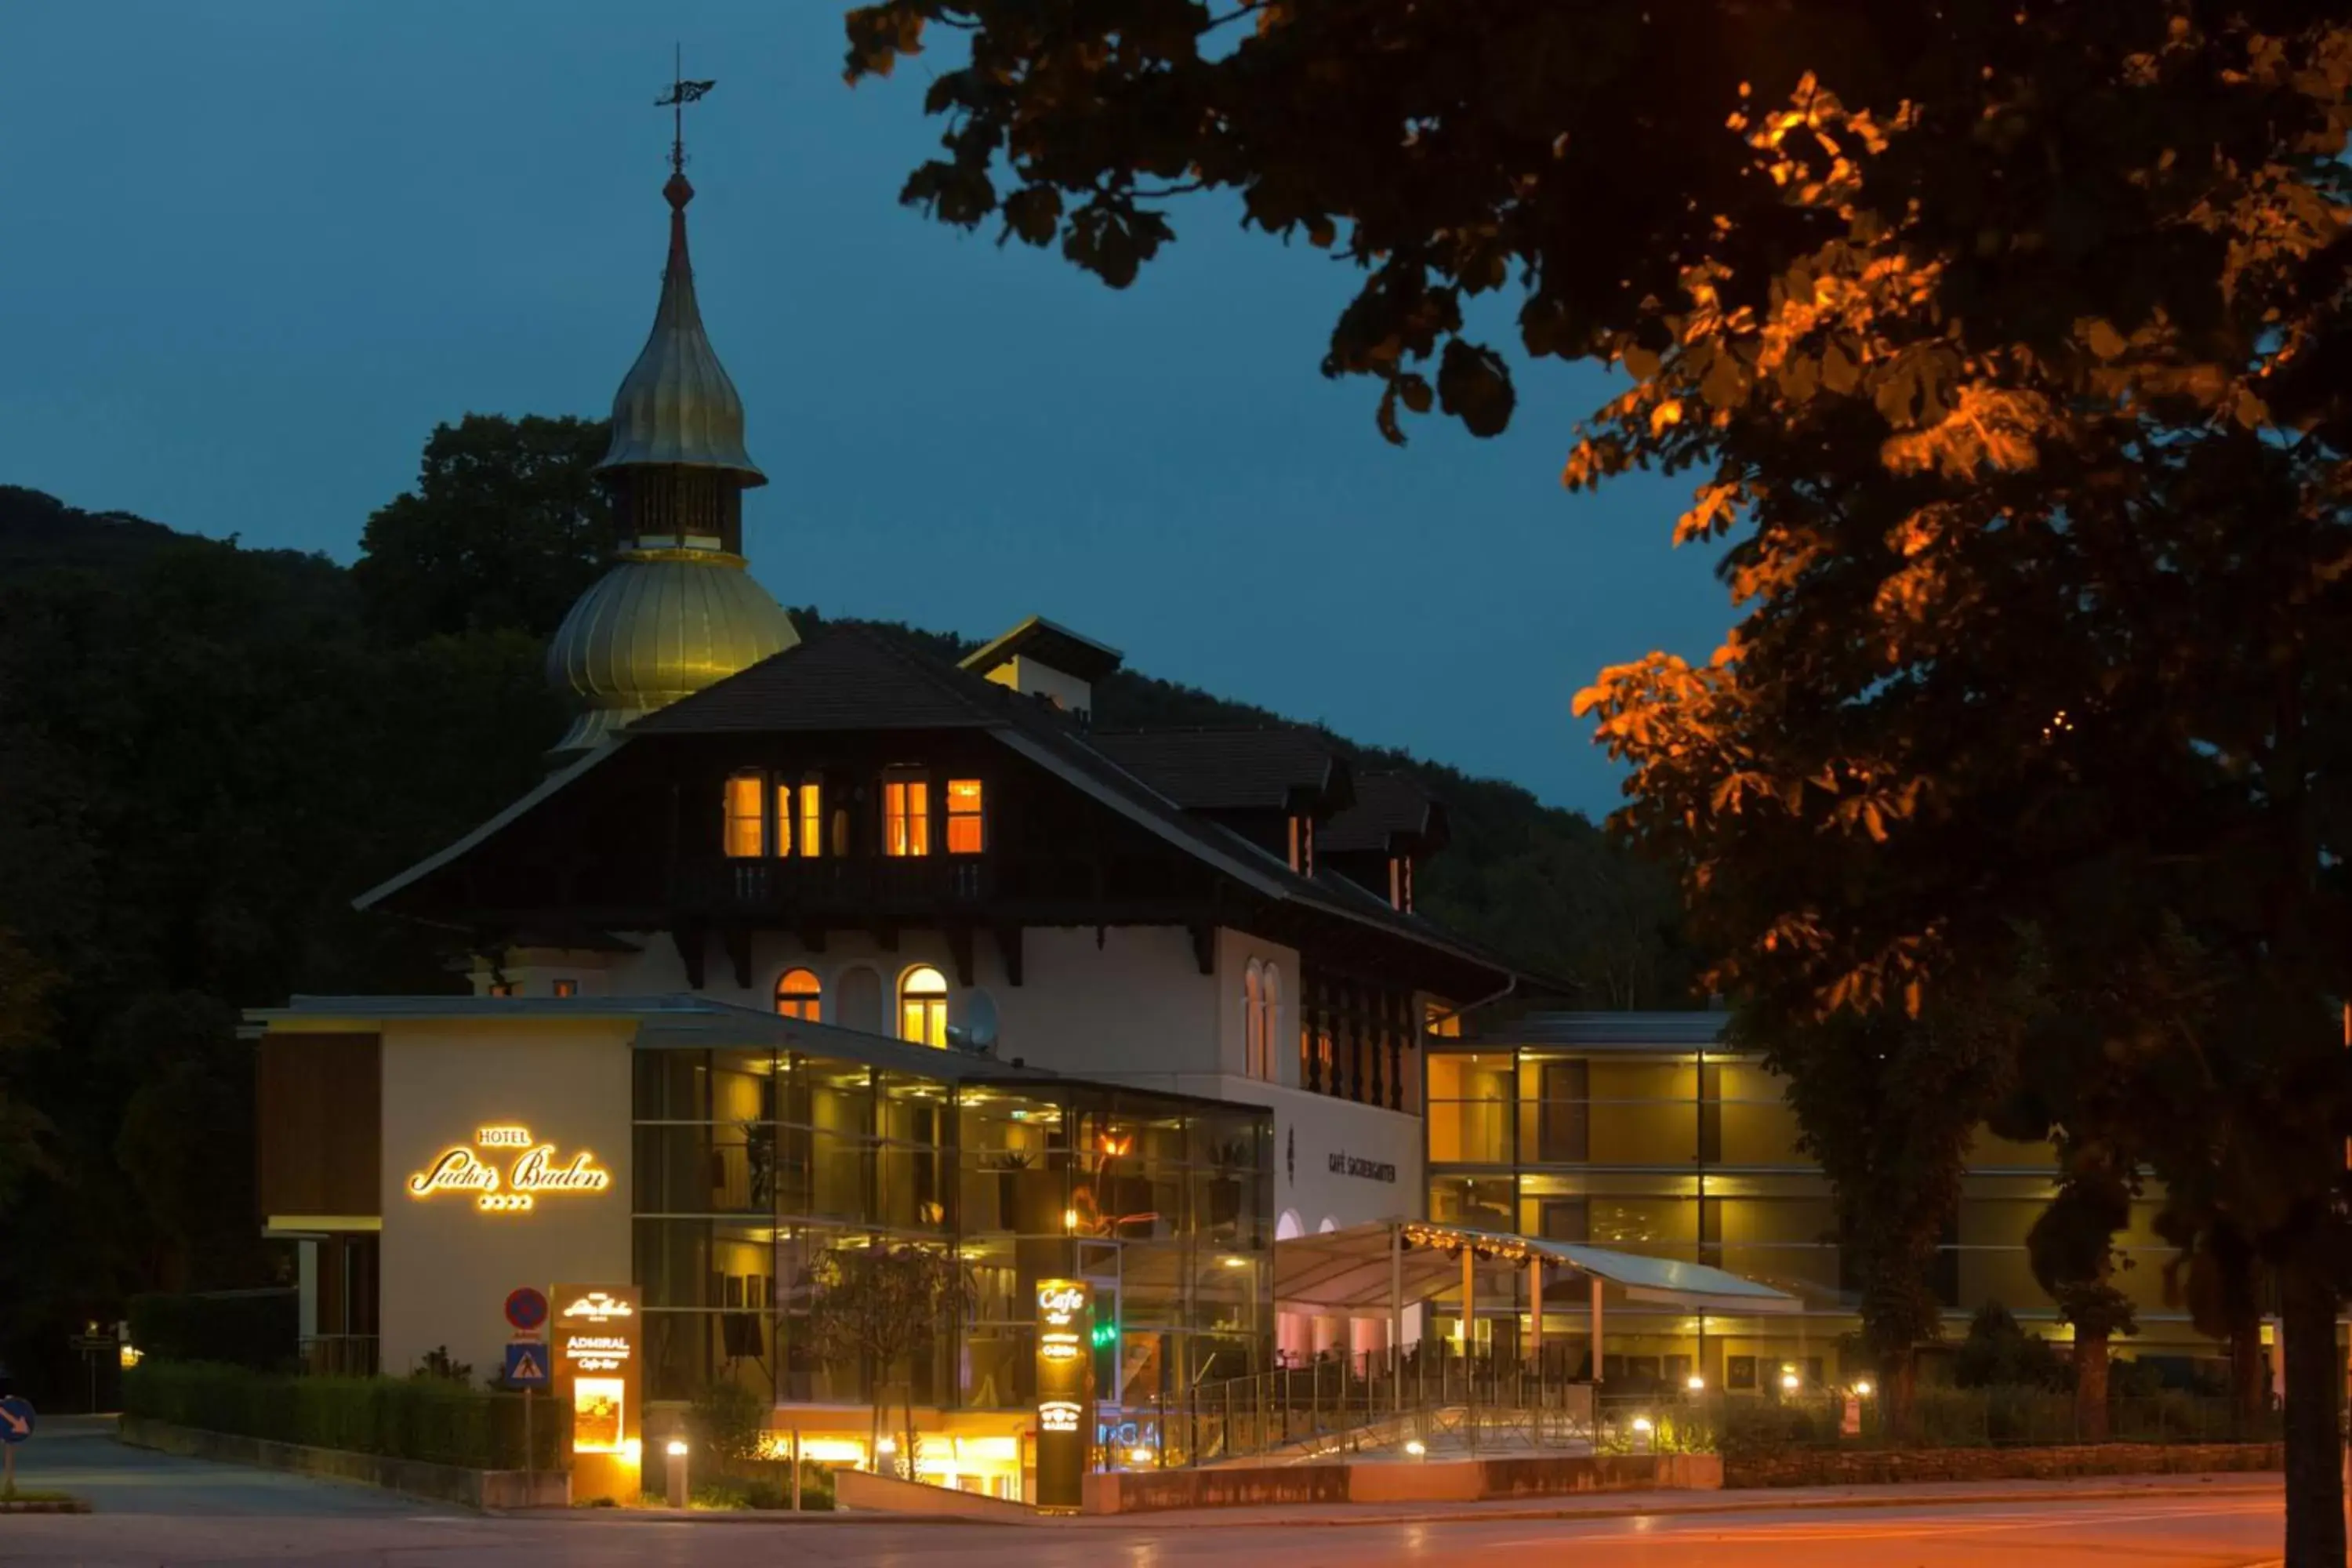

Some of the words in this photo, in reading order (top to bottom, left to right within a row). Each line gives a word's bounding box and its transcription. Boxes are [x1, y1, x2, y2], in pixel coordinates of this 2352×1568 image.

[478, 1129, 529, 1144] HOTEL
[410, 1149, 496, 1192] Sacher
[511, 1145, 606, 1189] Baden
[567, 1335, 630, 1349] ADMIRAL
